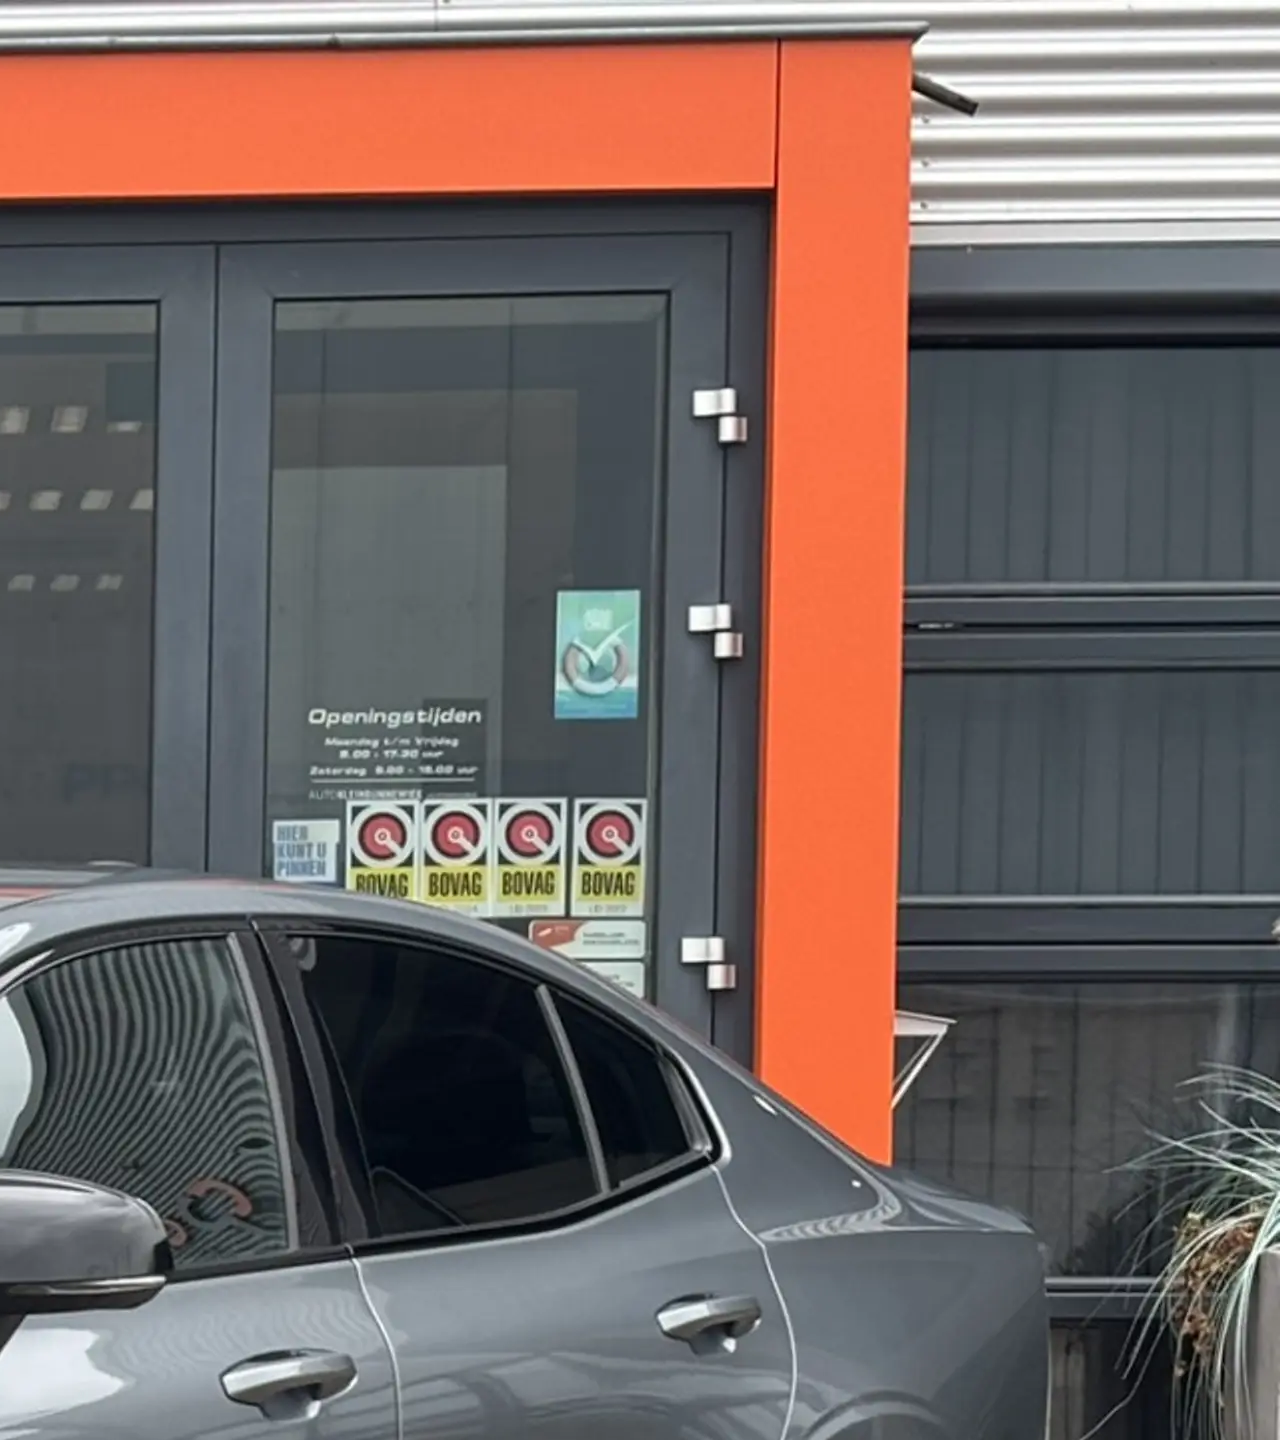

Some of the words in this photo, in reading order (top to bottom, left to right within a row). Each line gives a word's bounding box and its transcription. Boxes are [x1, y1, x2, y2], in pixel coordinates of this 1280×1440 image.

[308, 707, 482, 729] Openingstijden
[324, 737, 379, 748] Maandag
[384, 737, 411, 746] t/m
[309, 765, 368, 777] Zaterdag
[277, 824, 309, 841] HIER
[277, 842, 314, 859] KUNT
[317, 842, 327, 859] U
[355, 874, 409, 897] BOVAG
[428, 872, 482, 896] BOVAG
[502, 871, 556, 896] BOVAG
[581, 871, 636, 896] BOVAG
